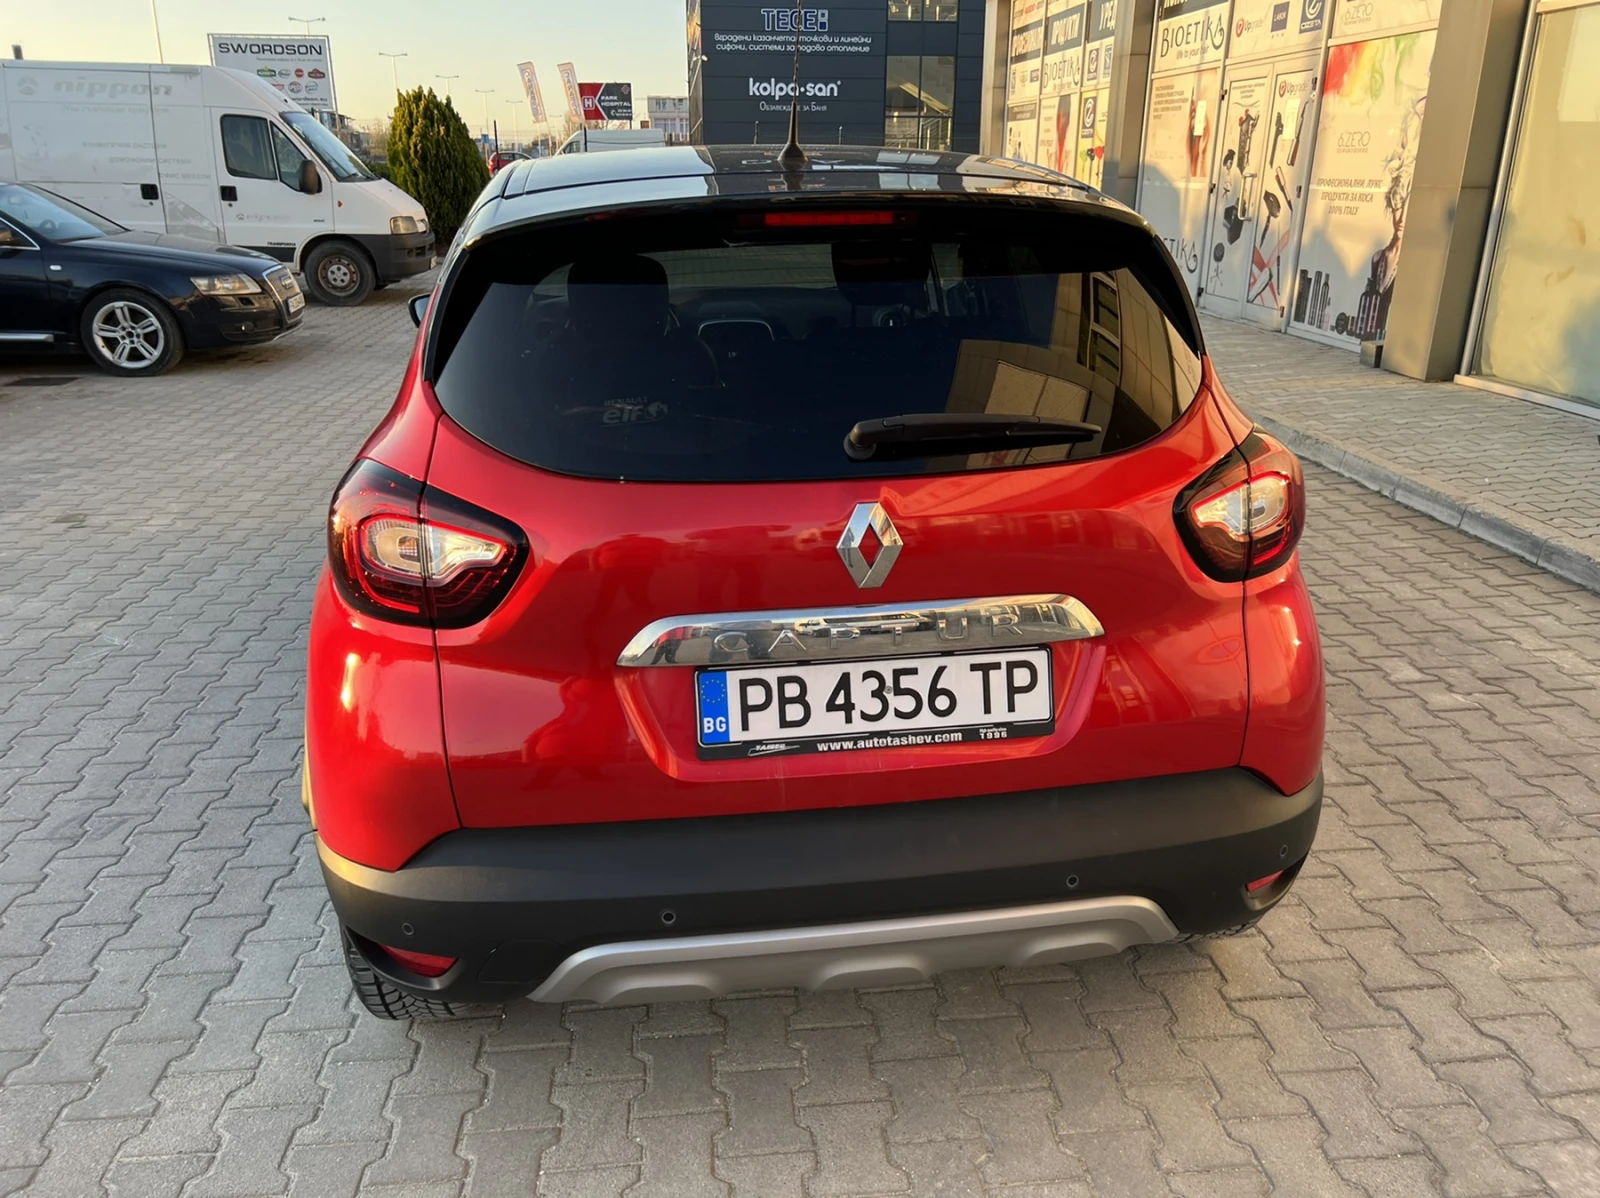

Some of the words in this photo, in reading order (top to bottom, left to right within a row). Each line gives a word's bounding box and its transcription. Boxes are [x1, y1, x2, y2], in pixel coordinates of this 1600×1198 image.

[761, 8, 817, 31] TECE
[1160, 13, 1225, 58] BIOETIKA
[218, 42, 323, 55] SWORDSON
[827, 45, 870, 53] отопление
[584, 98, 593, 108] H
[1338, 131, 1371, 147] 6.ZERO
[1321, 191, 1349, 202] ПРОДУКТИ
[1350, 192, 1357, 202] ЗА
[1358, 192, 1374, 203] КОСА
[714, 612, 1023, 653] CAPTUR
[739, 675, 811, 731] PB
[826, 665, 957, 724] 4356
[970, 660, 1038, 714] TP
[703, 717, 727, 733] BG
[817, 732, 963, 751] www.autotashev.com
